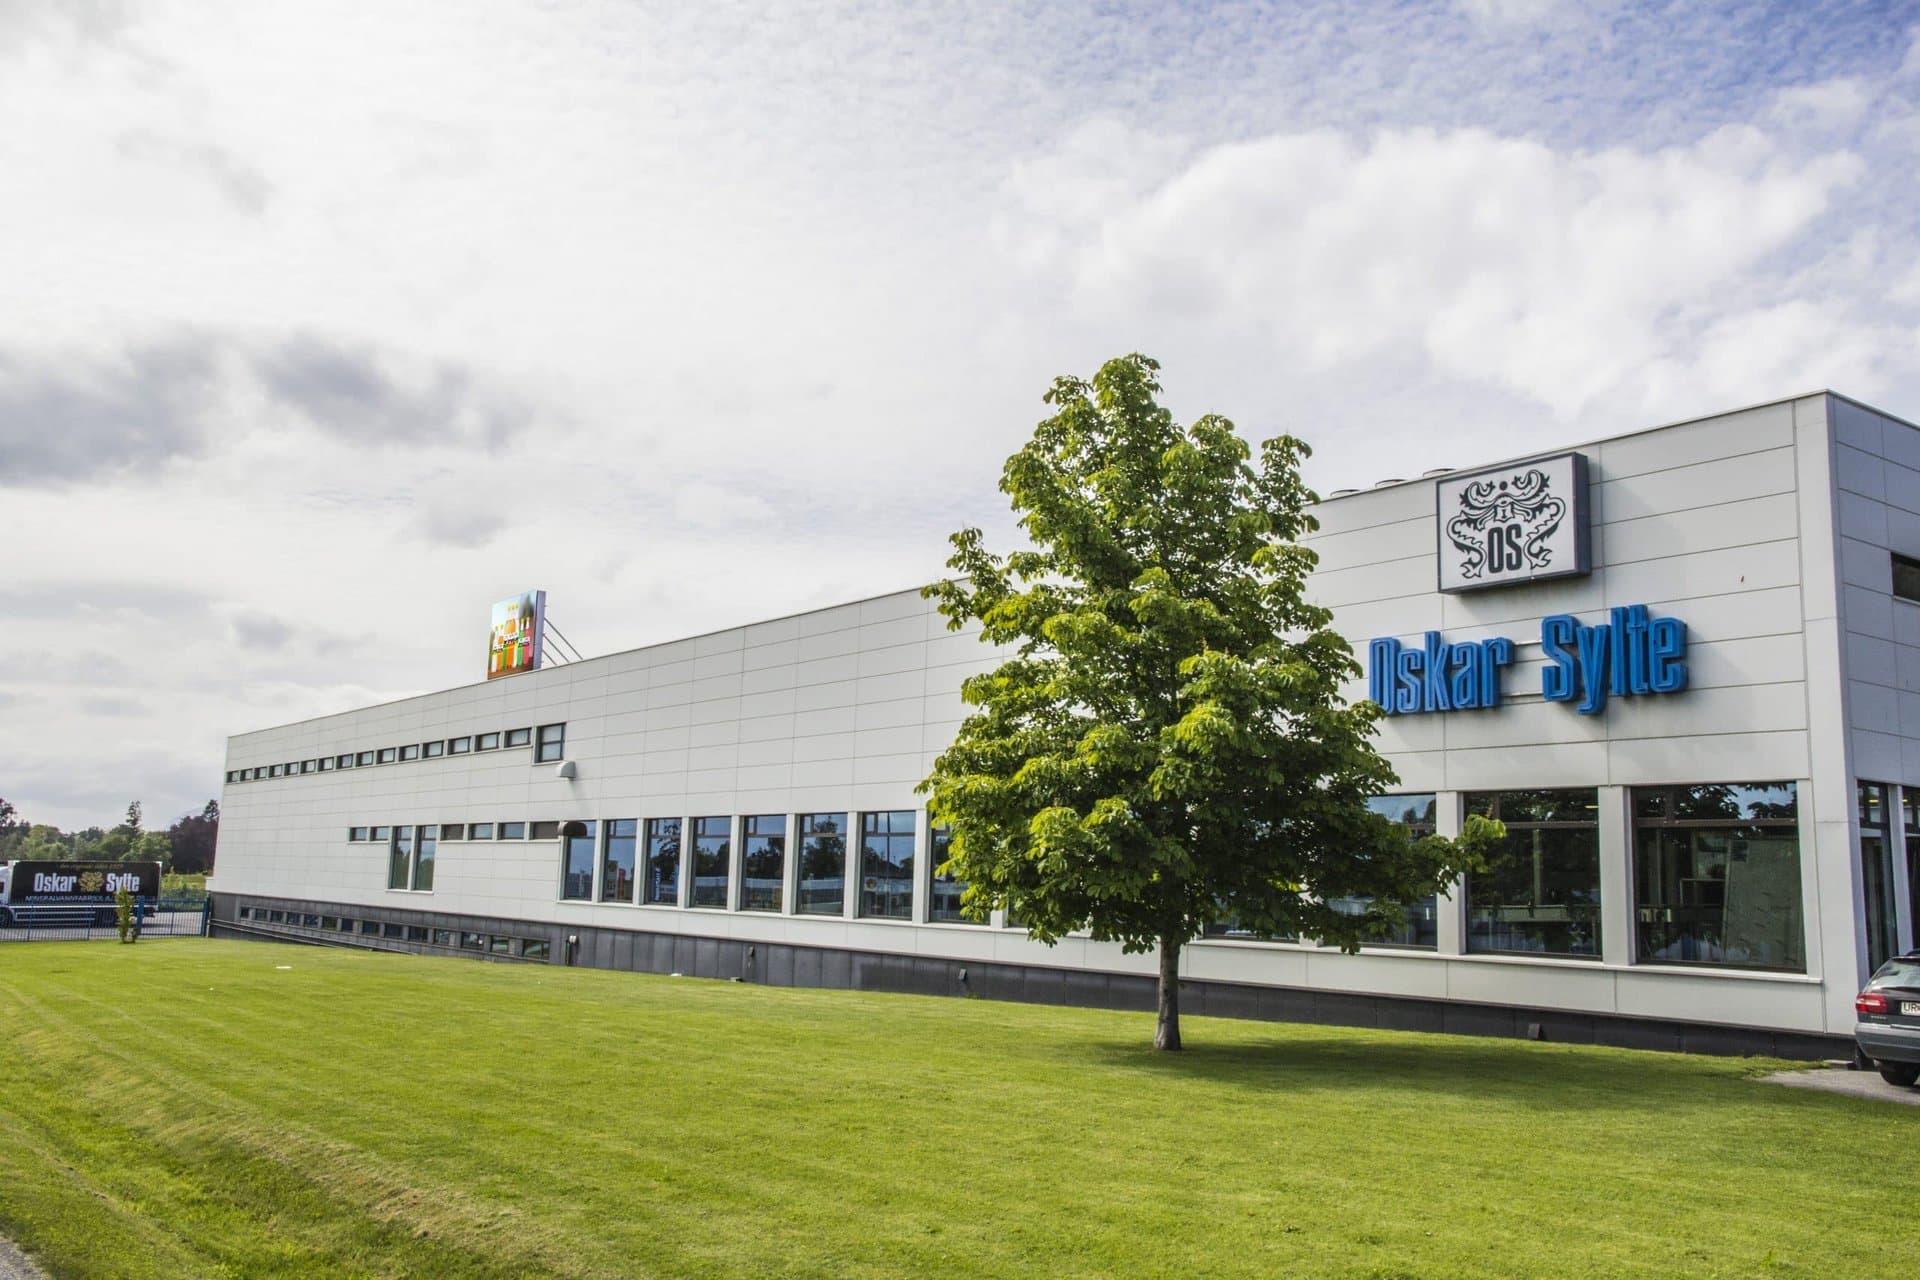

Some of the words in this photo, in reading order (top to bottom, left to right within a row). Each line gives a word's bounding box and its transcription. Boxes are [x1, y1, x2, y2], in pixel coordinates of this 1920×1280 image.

[1487, 523, 1523, 573] OS
[1369, 631, 1514, 716] Oskar
[1541, 604, 1689, 716] Sylte
[34, 872, 77, 892] Oskar
[106, 873, 140, 893] Sylte
